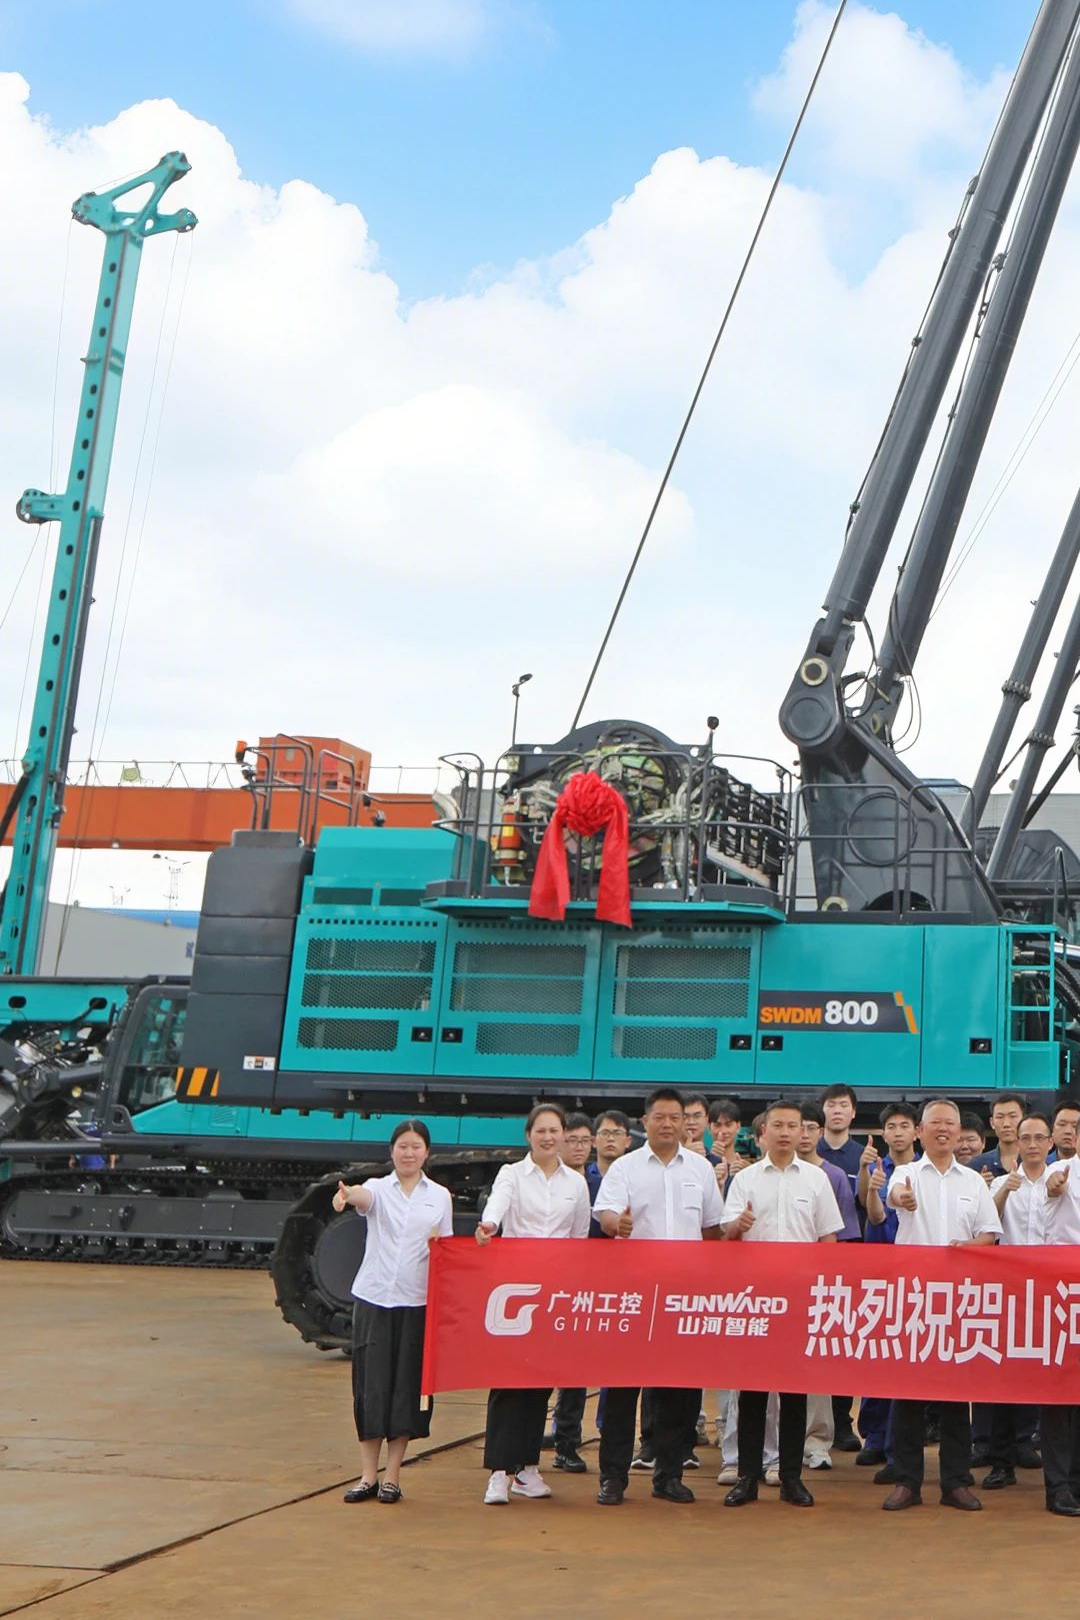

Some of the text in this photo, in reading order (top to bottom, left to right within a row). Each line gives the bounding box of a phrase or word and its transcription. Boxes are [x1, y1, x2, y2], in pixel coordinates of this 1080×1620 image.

[760, 1000, 879, 1025] SWDM 800
[547, 1290, 643, 1315] 广州工控
[664, 1285, 789, 1315] SUNWARD
[554, 1316, 630, 1332] GIIHG
[677, 1316, 770, 1337] 山河智能
